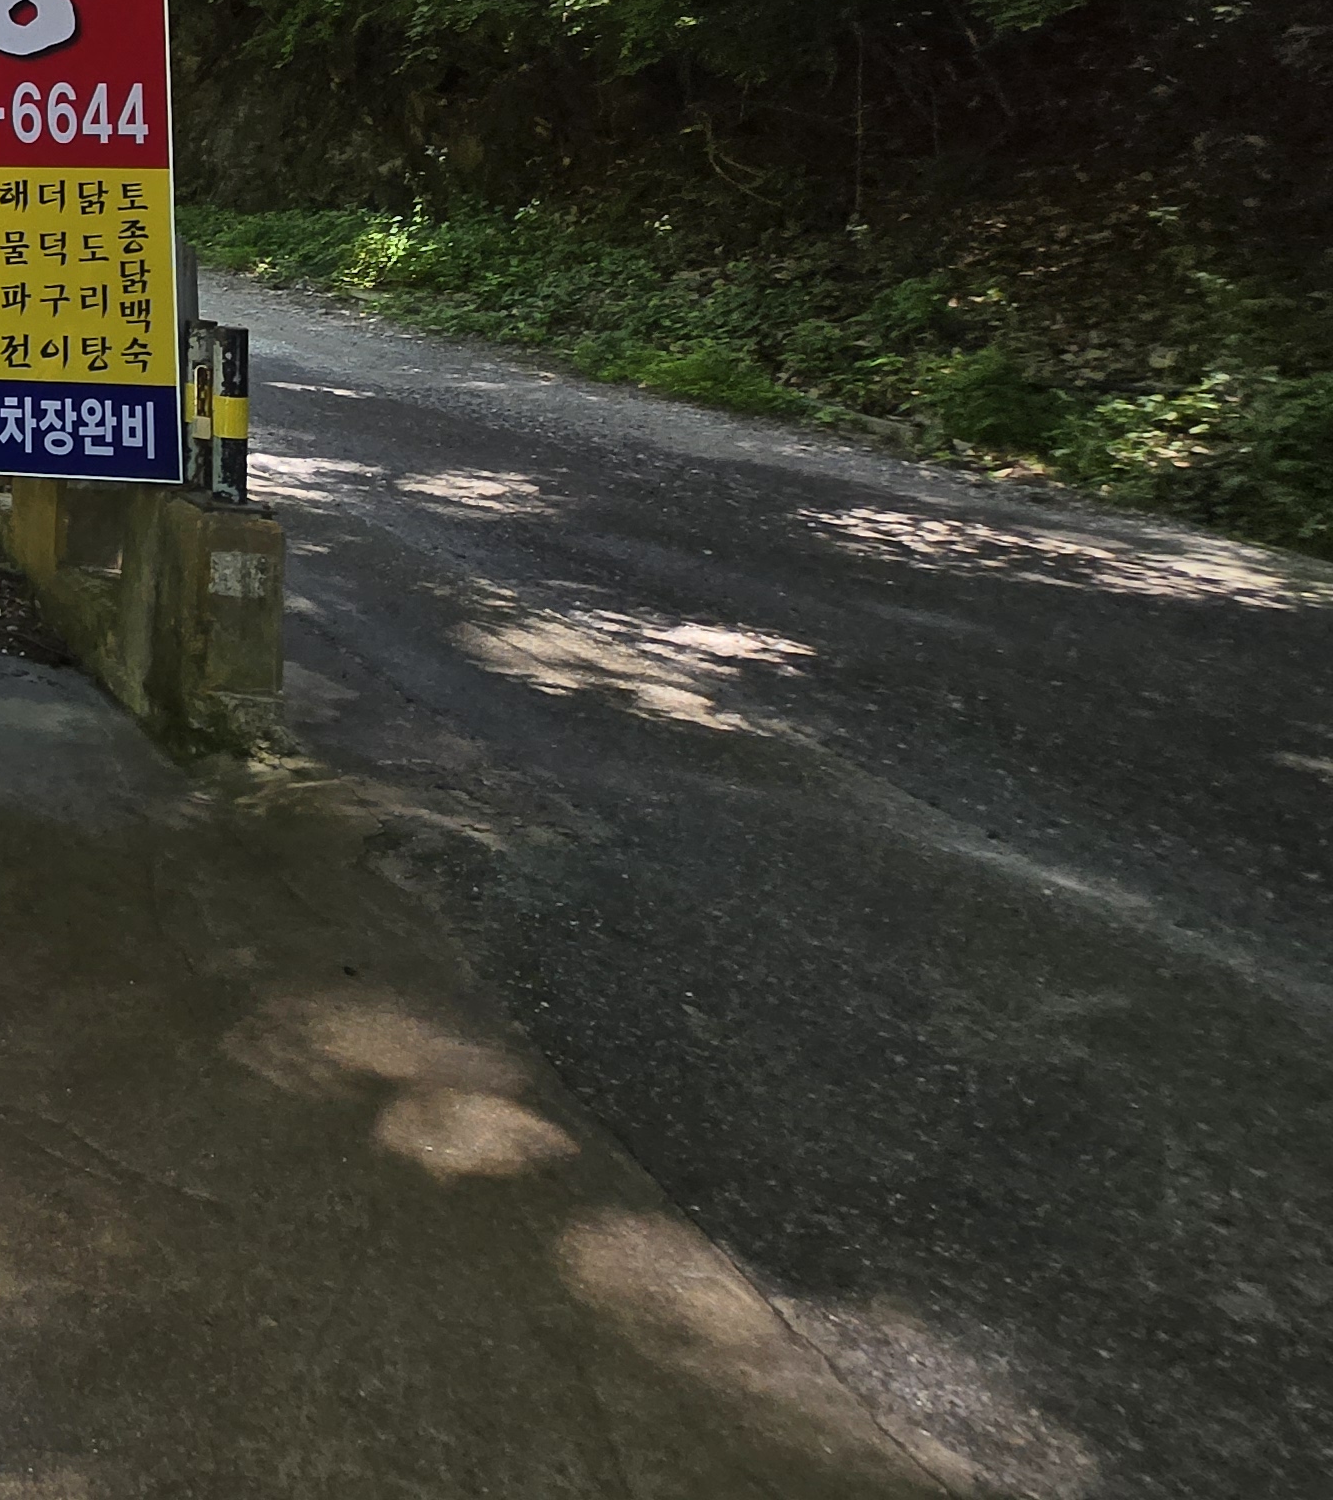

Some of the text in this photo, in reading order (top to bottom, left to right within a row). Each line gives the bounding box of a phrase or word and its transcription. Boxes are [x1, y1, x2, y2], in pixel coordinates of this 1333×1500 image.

[39, 180, 71, 369] 더덕구이
[77, 180, 113, 372] 닭도리탕
[116, 182, 153, 374] 토종닭백숙
